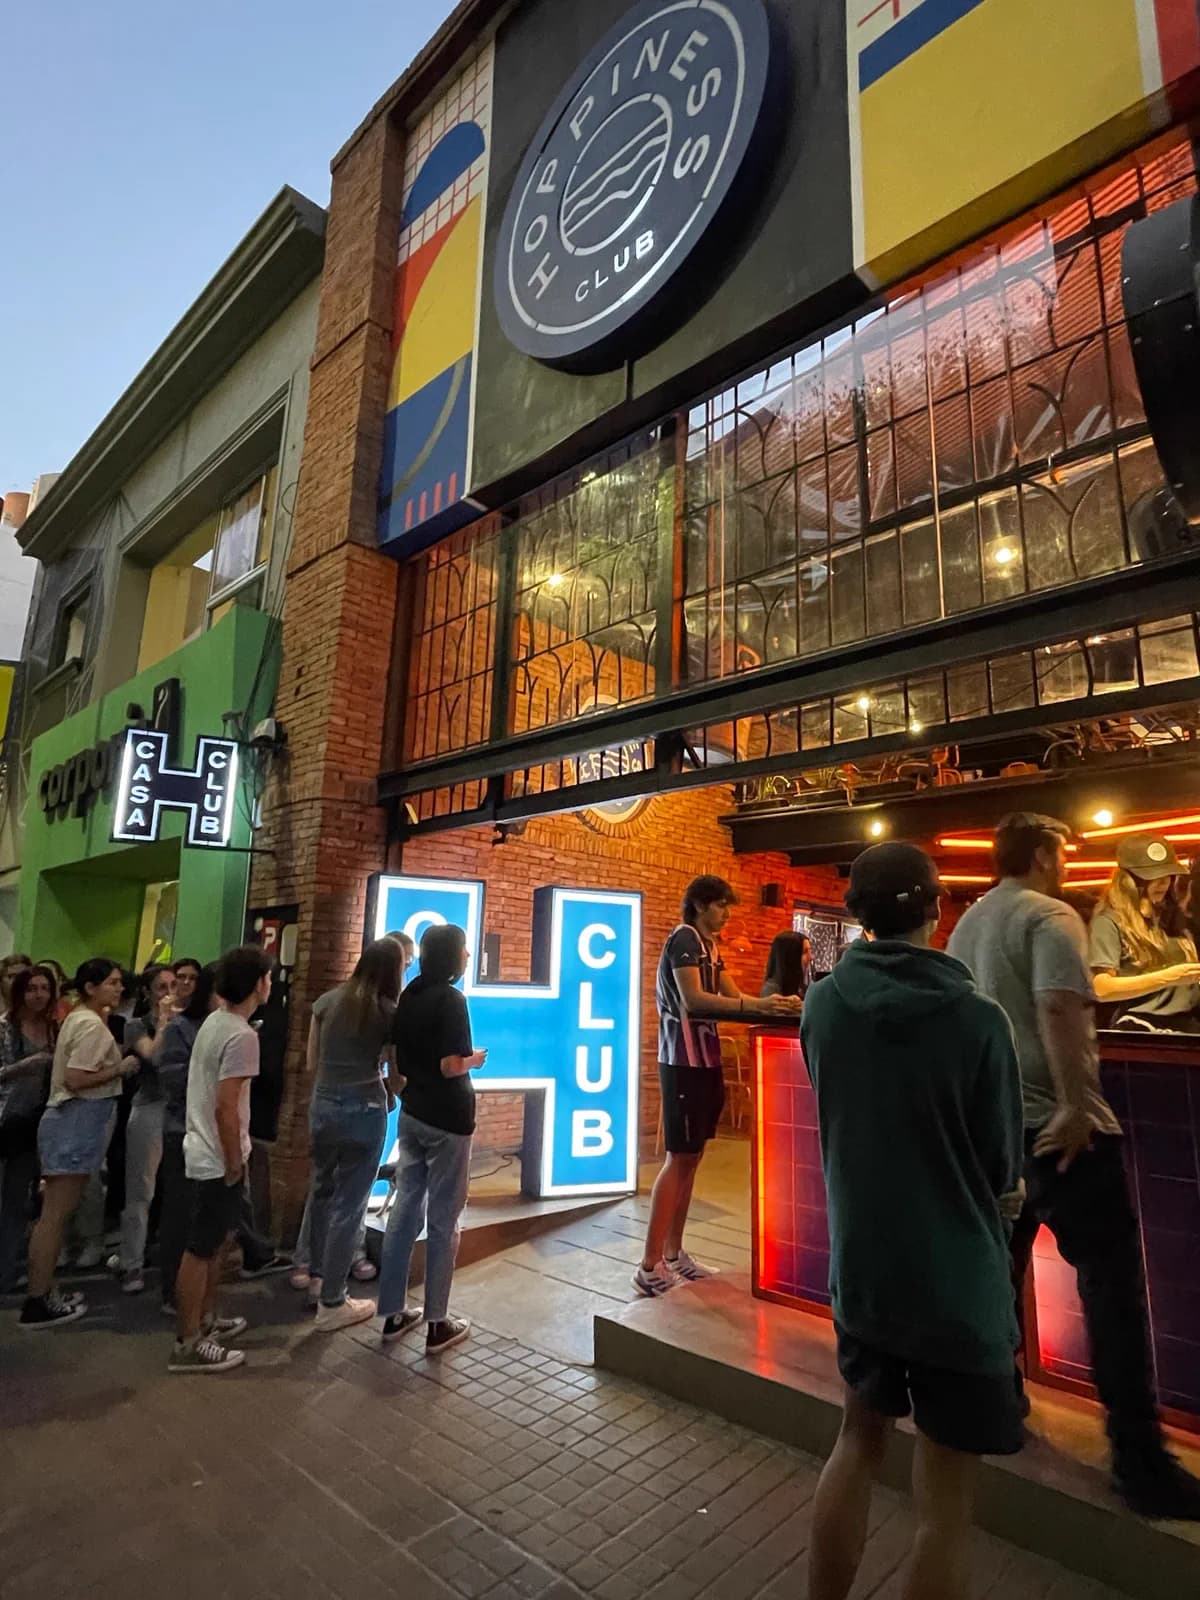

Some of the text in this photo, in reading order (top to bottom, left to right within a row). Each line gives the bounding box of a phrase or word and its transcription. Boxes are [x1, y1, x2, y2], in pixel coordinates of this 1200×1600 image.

[524, 29, 722, 300] HOPPINESS
[574, 229, 655, 303] CLUB
[126, 740, 155, 828] CASA
[199, 750, 227, 835] CLUB
[570, 922, 618, 1159] CLUB
